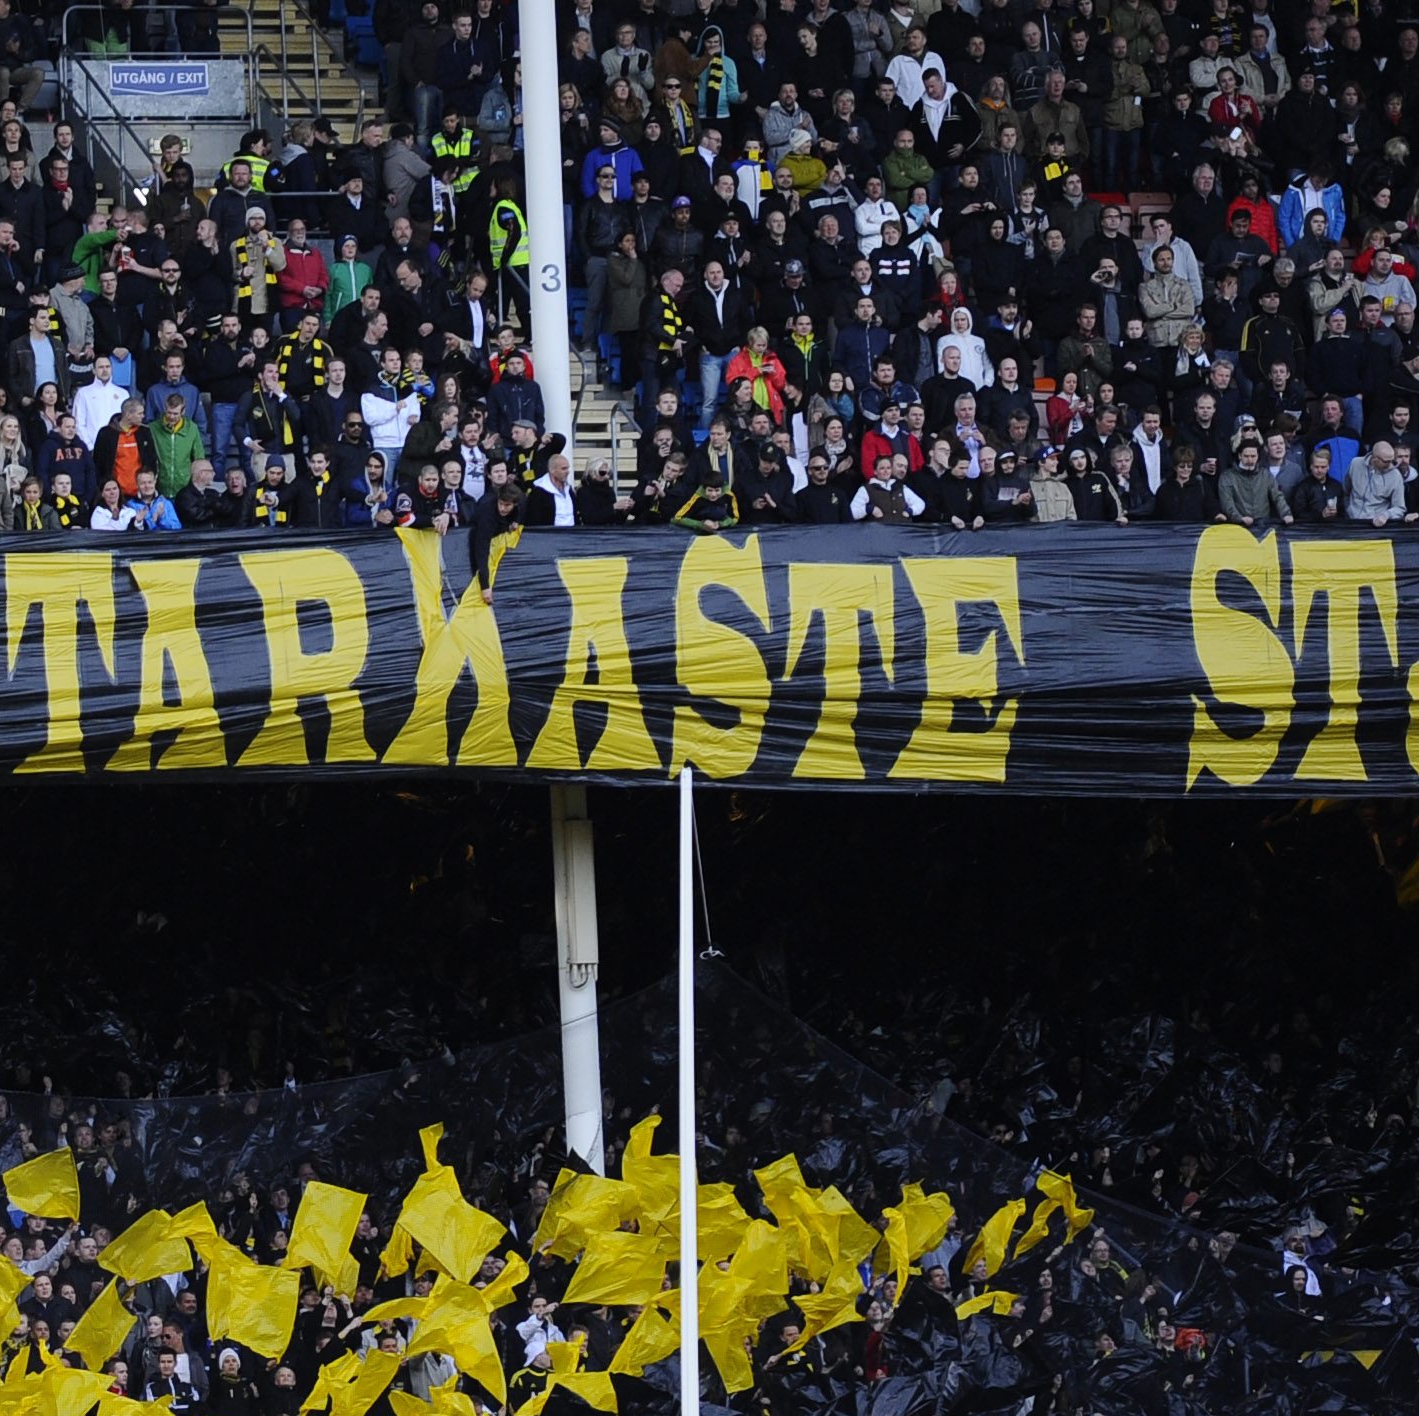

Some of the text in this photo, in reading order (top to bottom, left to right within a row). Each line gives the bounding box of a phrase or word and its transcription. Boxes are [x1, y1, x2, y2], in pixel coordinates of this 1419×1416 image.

[113, 69, 205, 85] UTGÅNG / EXIT
[541, 263, 562, 292] 3
[1186, 525, 1419, 794] ST
